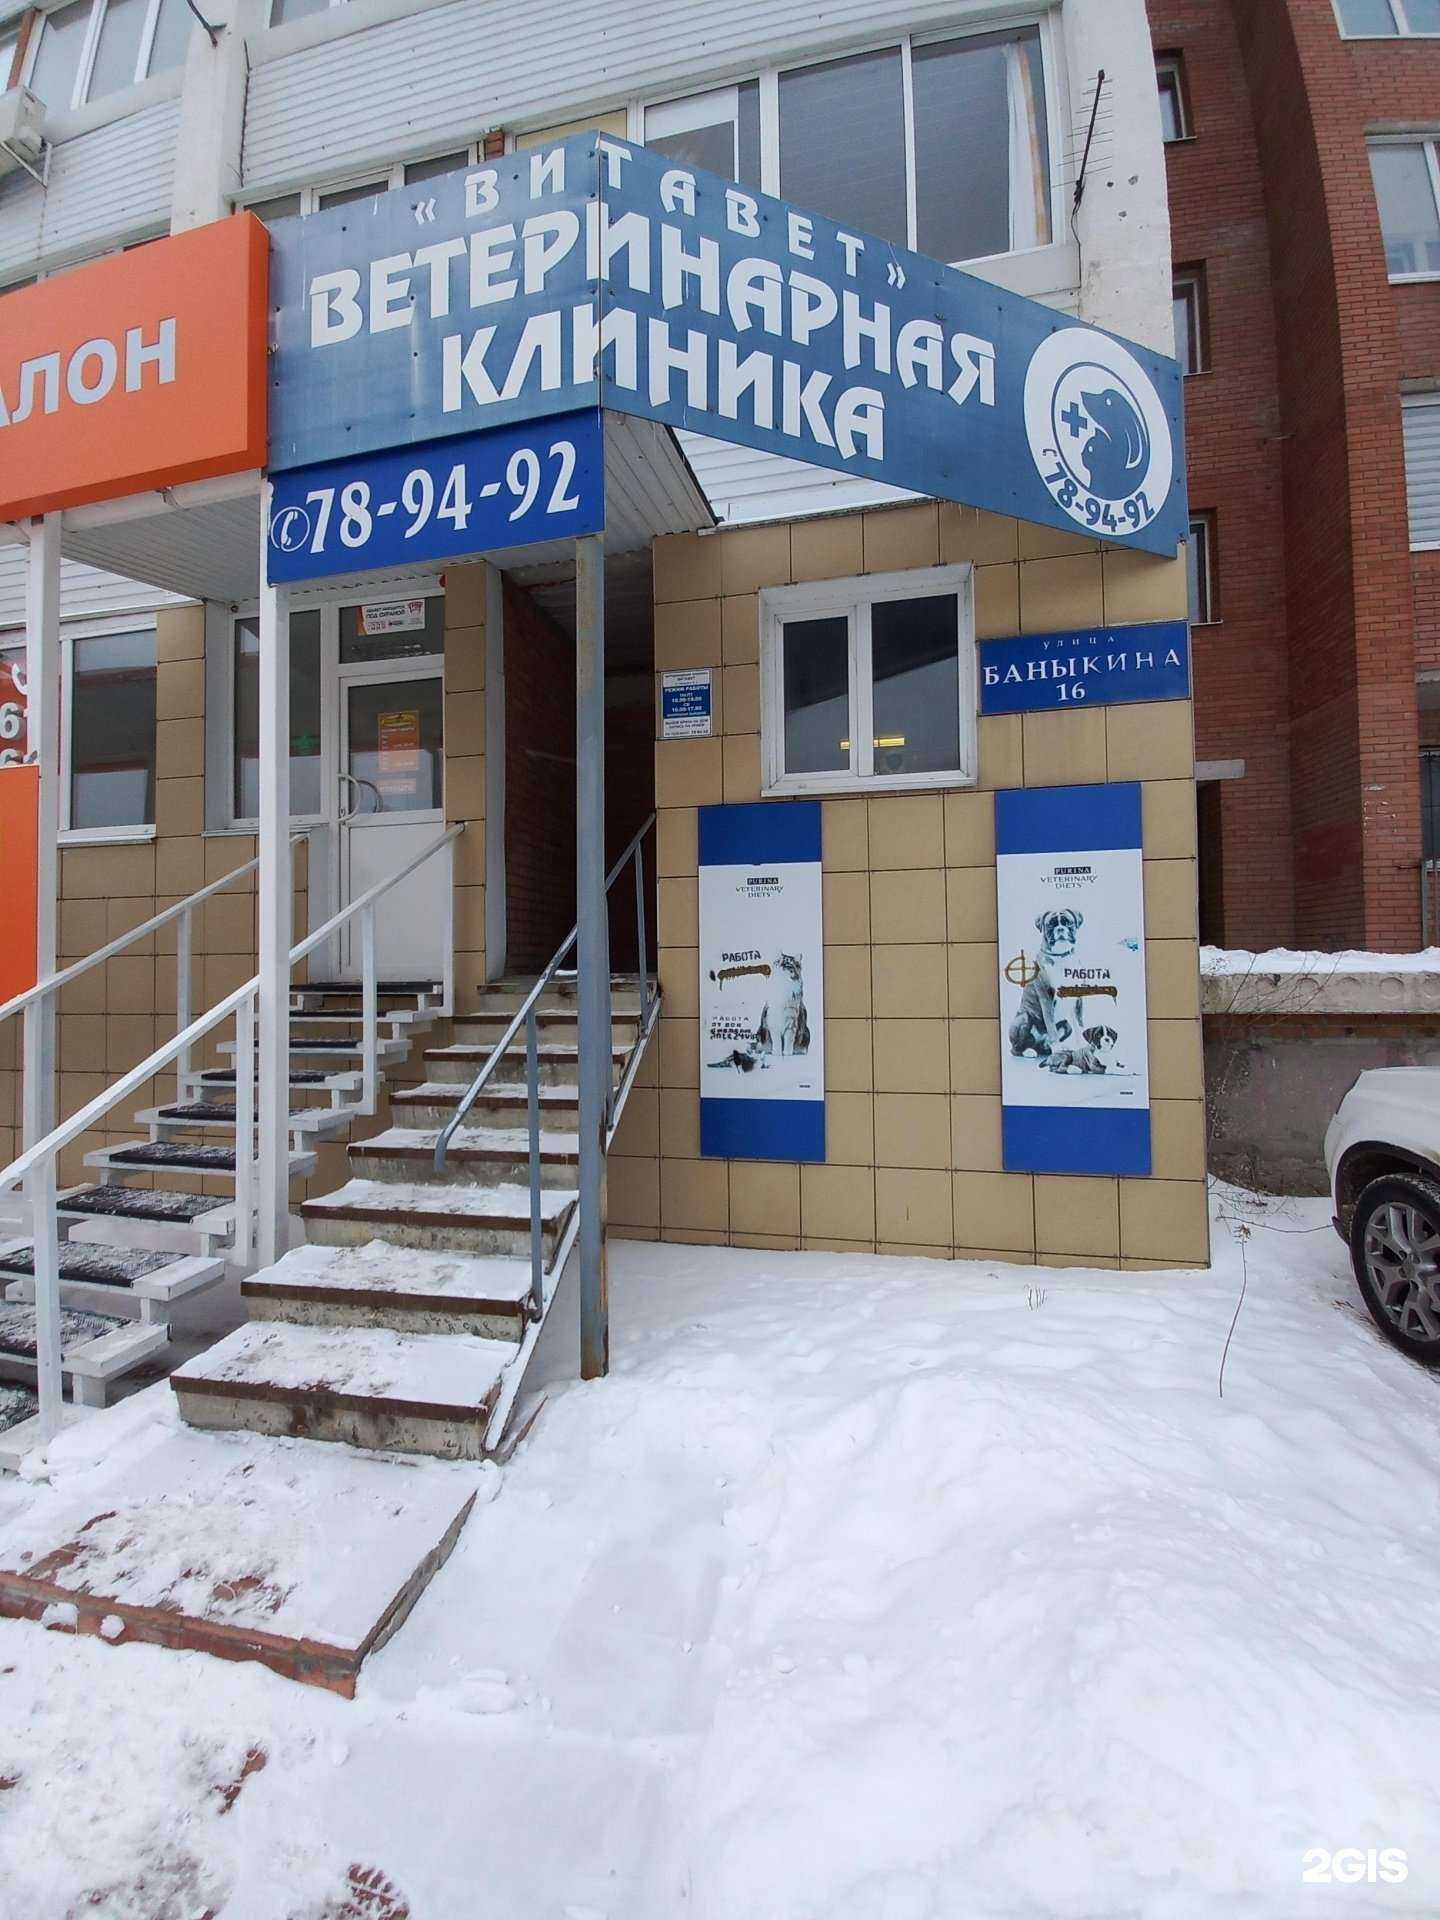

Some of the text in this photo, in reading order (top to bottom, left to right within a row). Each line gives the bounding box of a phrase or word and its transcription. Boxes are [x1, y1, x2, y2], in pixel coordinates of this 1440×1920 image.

[308, 199, 997, 407] ВЕТЕРИНАРНАЯ
[0, 316, 176, 427] ЛОН
[442, 302, 886, 460] КЛИНИКА
[305, 440, 580, 554] 78-94-92
[983, 648, 1181, 686] БАНЫКИНА
[1056, 681, 1086, 701] 16
[1040, 875, 1098, 883] VETERINARY
[1055, 866, 1091, 875] PURINA
[722, 950, 761, 962] РАБОТА
[1064, 968, 1110, 980] РАБОТА
